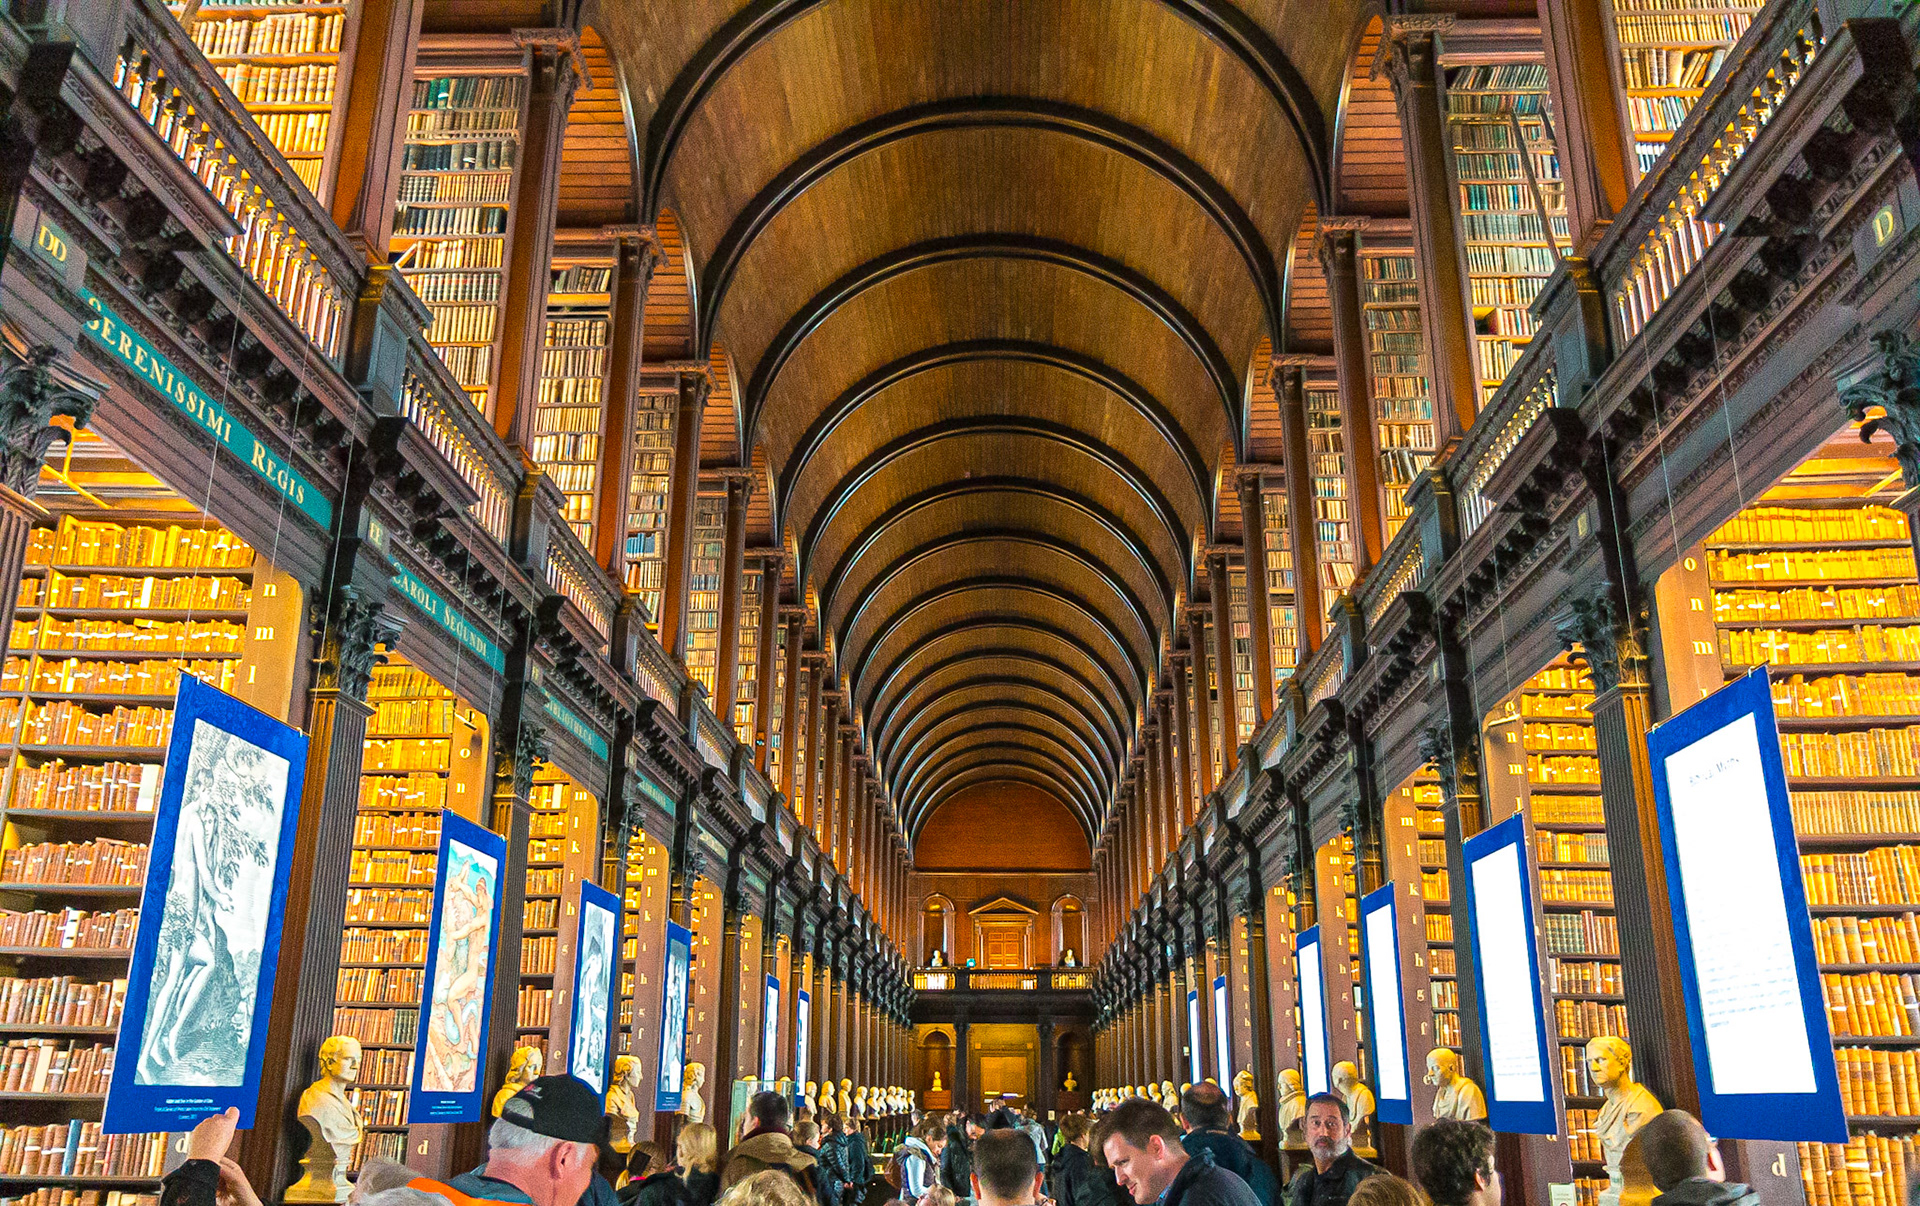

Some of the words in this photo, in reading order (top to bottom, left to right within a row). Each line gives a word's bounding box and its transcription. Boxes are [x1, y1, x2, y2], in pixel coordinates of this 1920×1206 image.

[1875, 211, 1893, 242] D
[38, 225, 67, 262] DD
[251, 439, 305, 504] REGIS
[1684, 557, 1697, 571] o
[263, 583, 276, 597] n
[1690, 598, 1704, 611] n
[254, 626, 275, 640] m
[1692, 641, 1714, 655] m
[1506, 731, 1517, 743] n
[459, 748, 471, 758] o
[1508, 763, 1523, 775] m
[456, 782, 465, 794] n
[1401, 787, 1410, 797] n
[574, 791, 587, 801] m
[1400, 816, 1414, 827] m
[571, 841, 580, 853] k
[648, 846, 655, 855] n
[1329, 856, 1340, 865] m
[569, 870, 575, 883] i
[646, 867, 657, 876] m
[1273, 886, 1285, 896] m
[1409, 883, 1419, 896] k
[566, 901, 576, 916] h
[1335, 905, 1344, 918] k
[644, 909, 651, 922] k
[1411, 913, 1417, 925] i
[702, 935, 709, 945] k
[1280, 933, 1287, 944] k
[1414, 952, 1424, 967] h
[743, 964, 749, 972] k
[1339, 963, 1346, 974] h
[640, 973, 647, 985] h
[700, 985, 706, 995] h
[1283, 980, 1290, 991] h
[1416, 988, 1425, 1001] g
[553, 1050, 562, 1060] e
[417, 1140, 428, 1155] d
[1771, 1152, 1787, 1177] d
